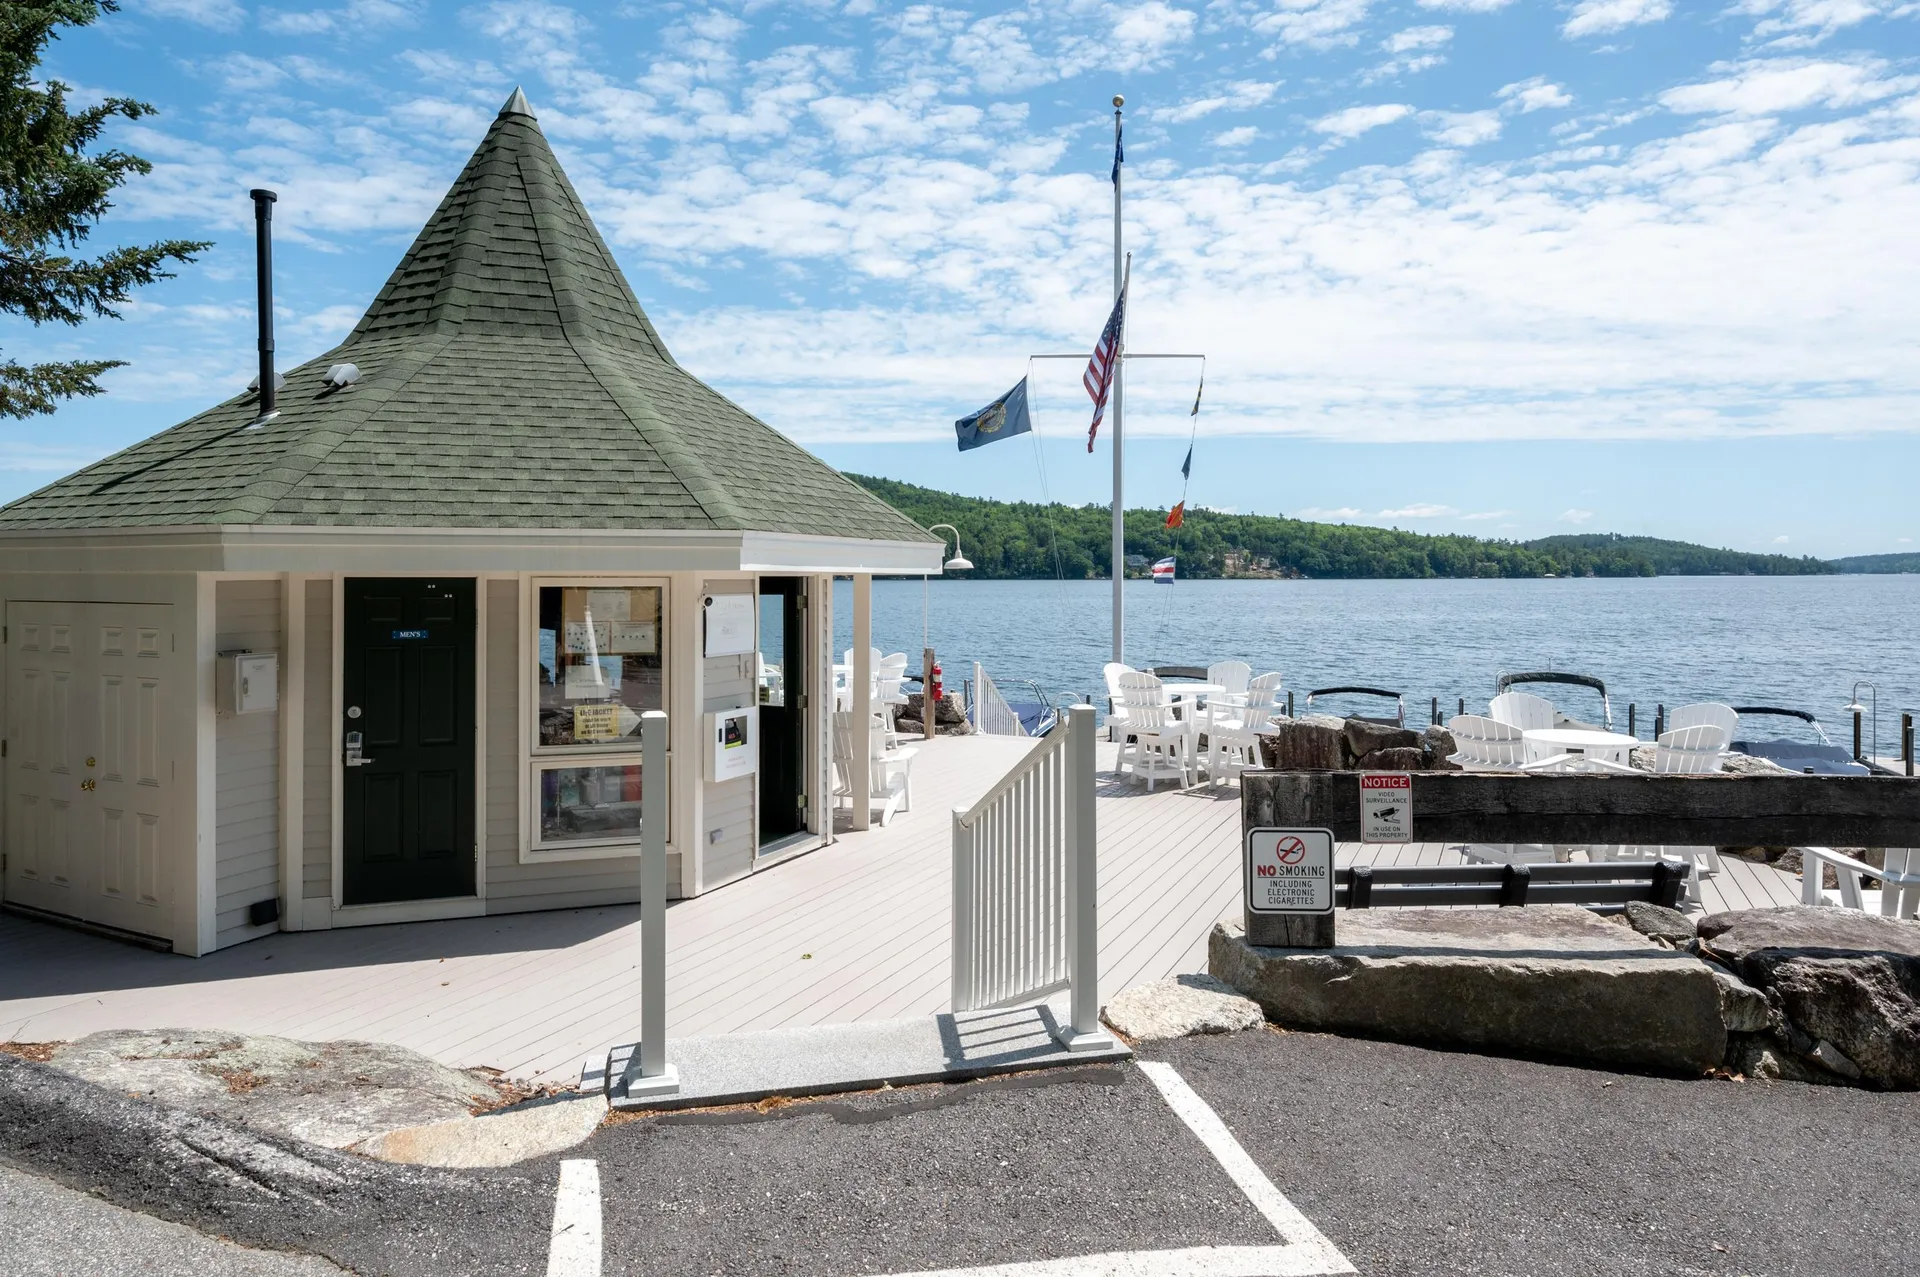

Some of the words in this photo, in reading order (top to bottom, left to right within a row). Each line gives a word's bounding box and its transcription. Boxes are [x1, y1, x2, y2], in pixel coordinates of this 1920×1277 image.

[1363, 777, 1407, 787] NOTICE
[1257, 865, 1276, 876] NO
[1279, 865, 1325, 876] SMOKING
[1269, 880, 1312, 888] INCLUDING
[1267, 889, 1315, 897] ELECTRONIC
[1268, 897, 1314, 905] CIGARETTES
